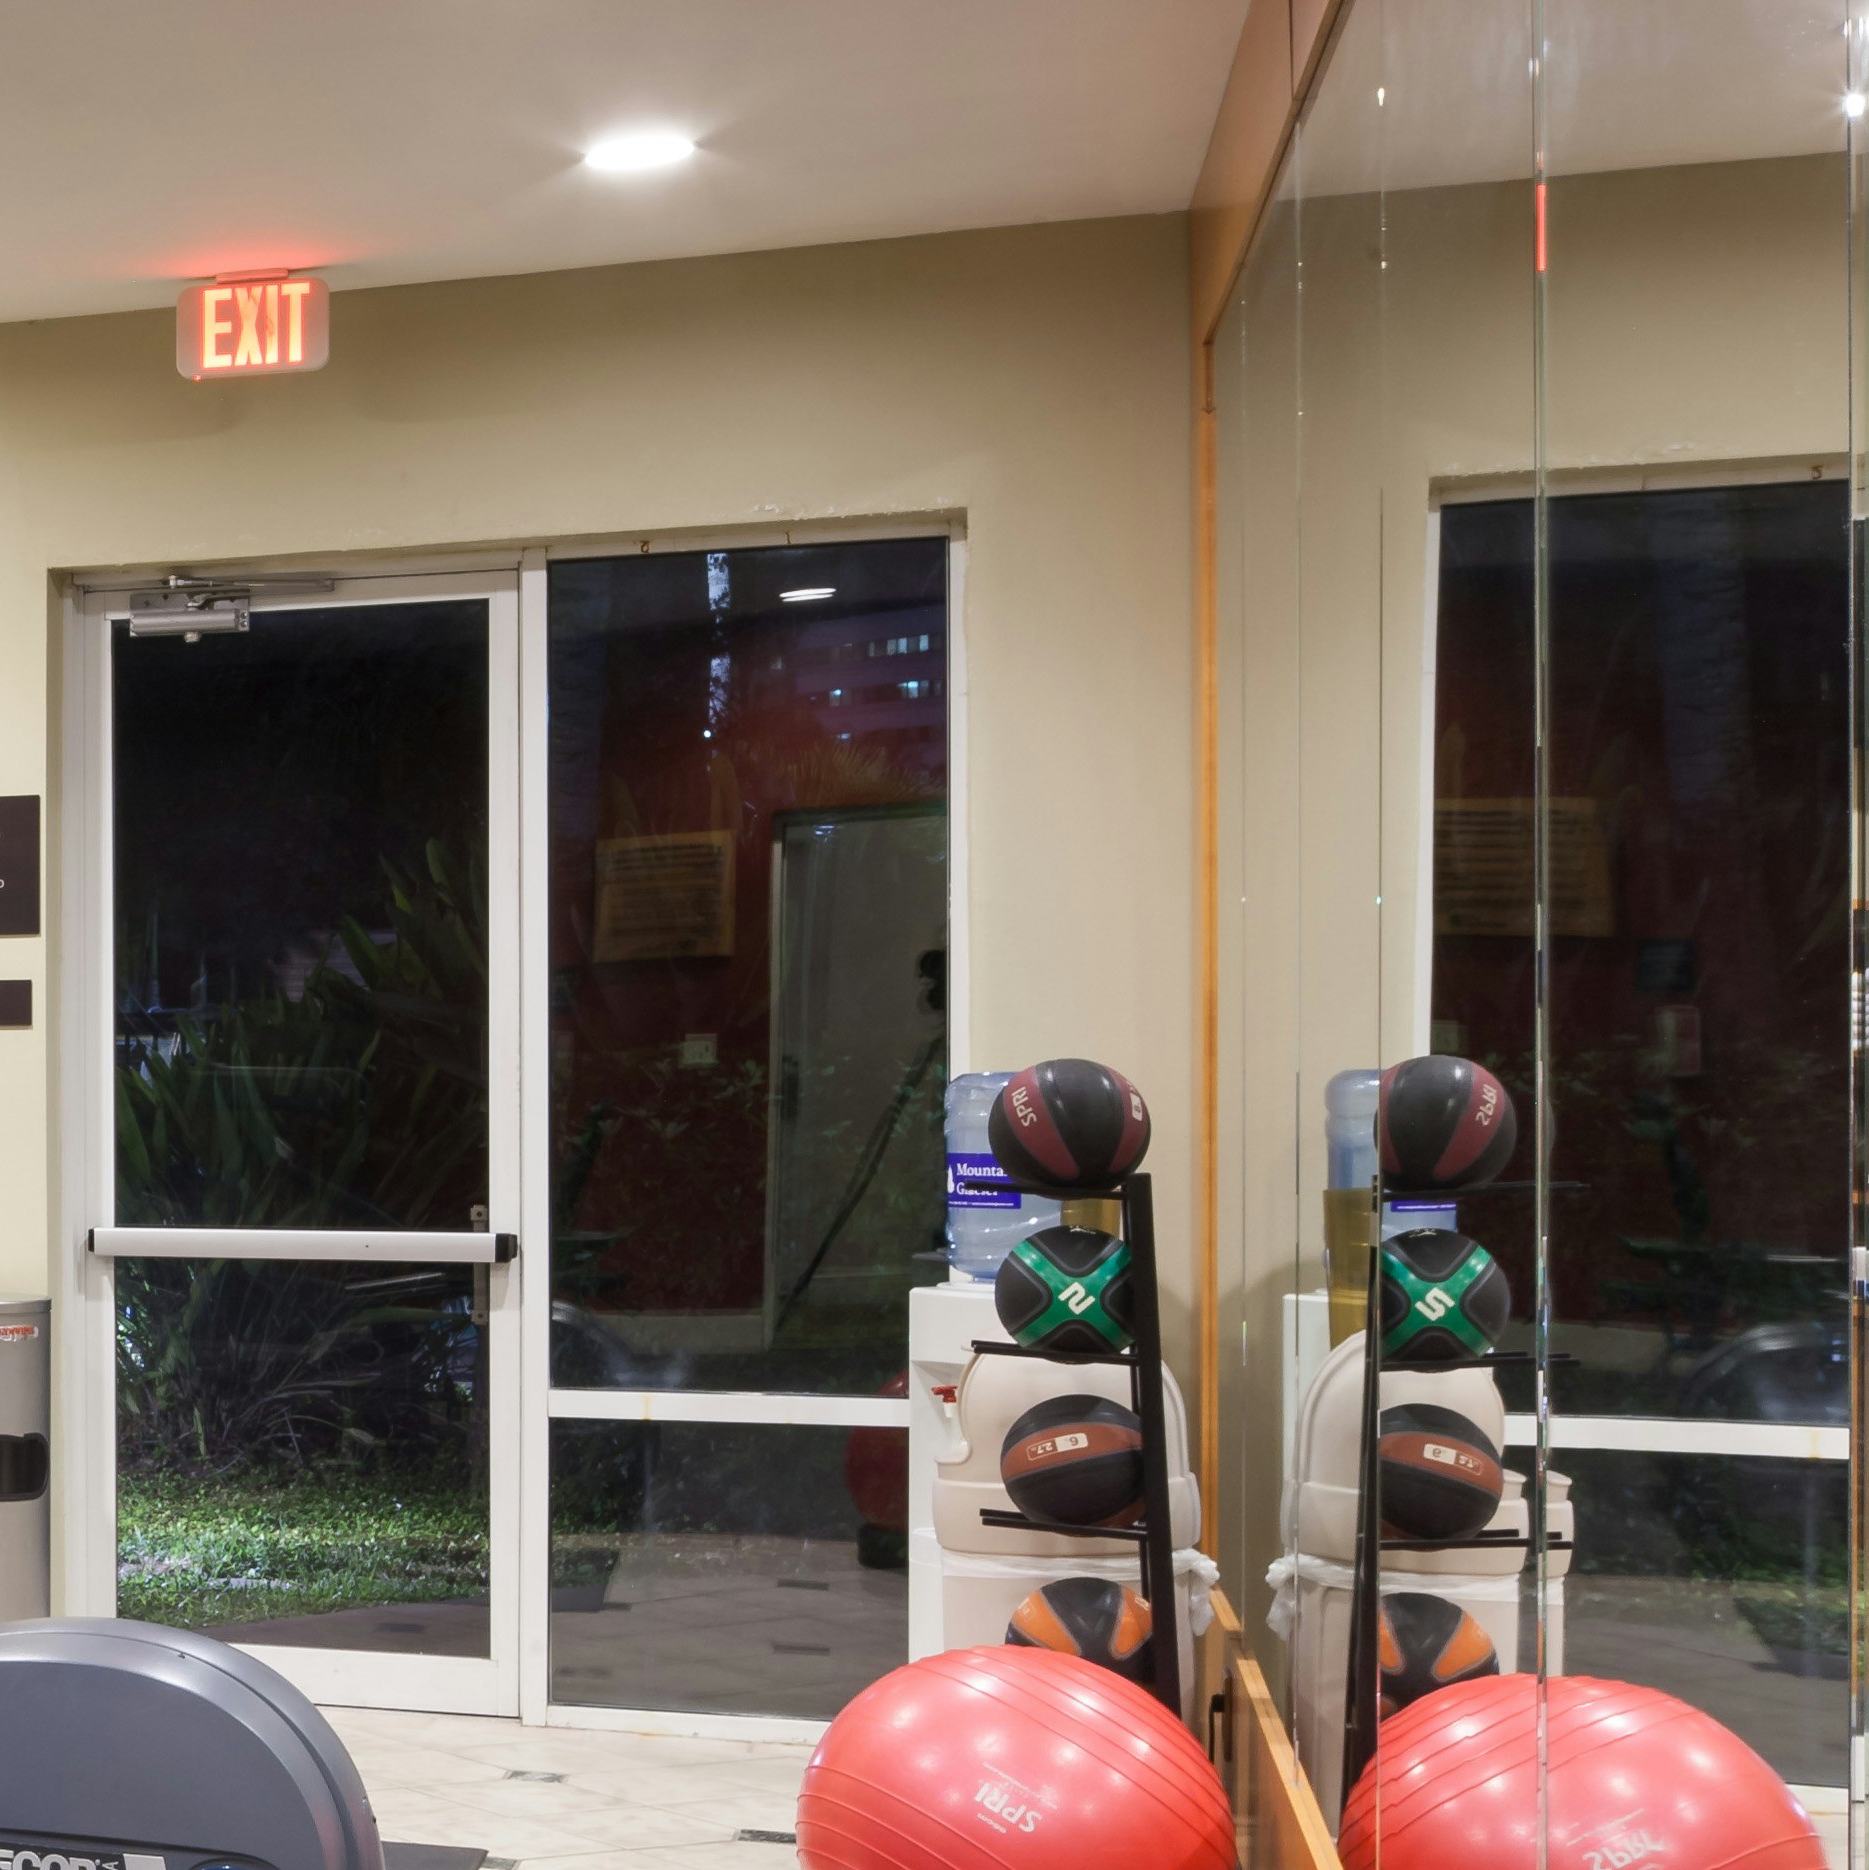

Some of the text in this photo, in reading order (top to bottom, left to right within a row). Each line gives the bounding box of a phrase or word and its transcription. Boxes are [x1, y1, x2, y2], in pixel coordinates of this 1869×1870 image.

[203, 282, 310, 369] EXIT
[1011, 1086, 1037, 1127] SPRI
[956, 1163, 1008, 1177] Mounta
[973, 1782, 1043, 1833] SPRI
